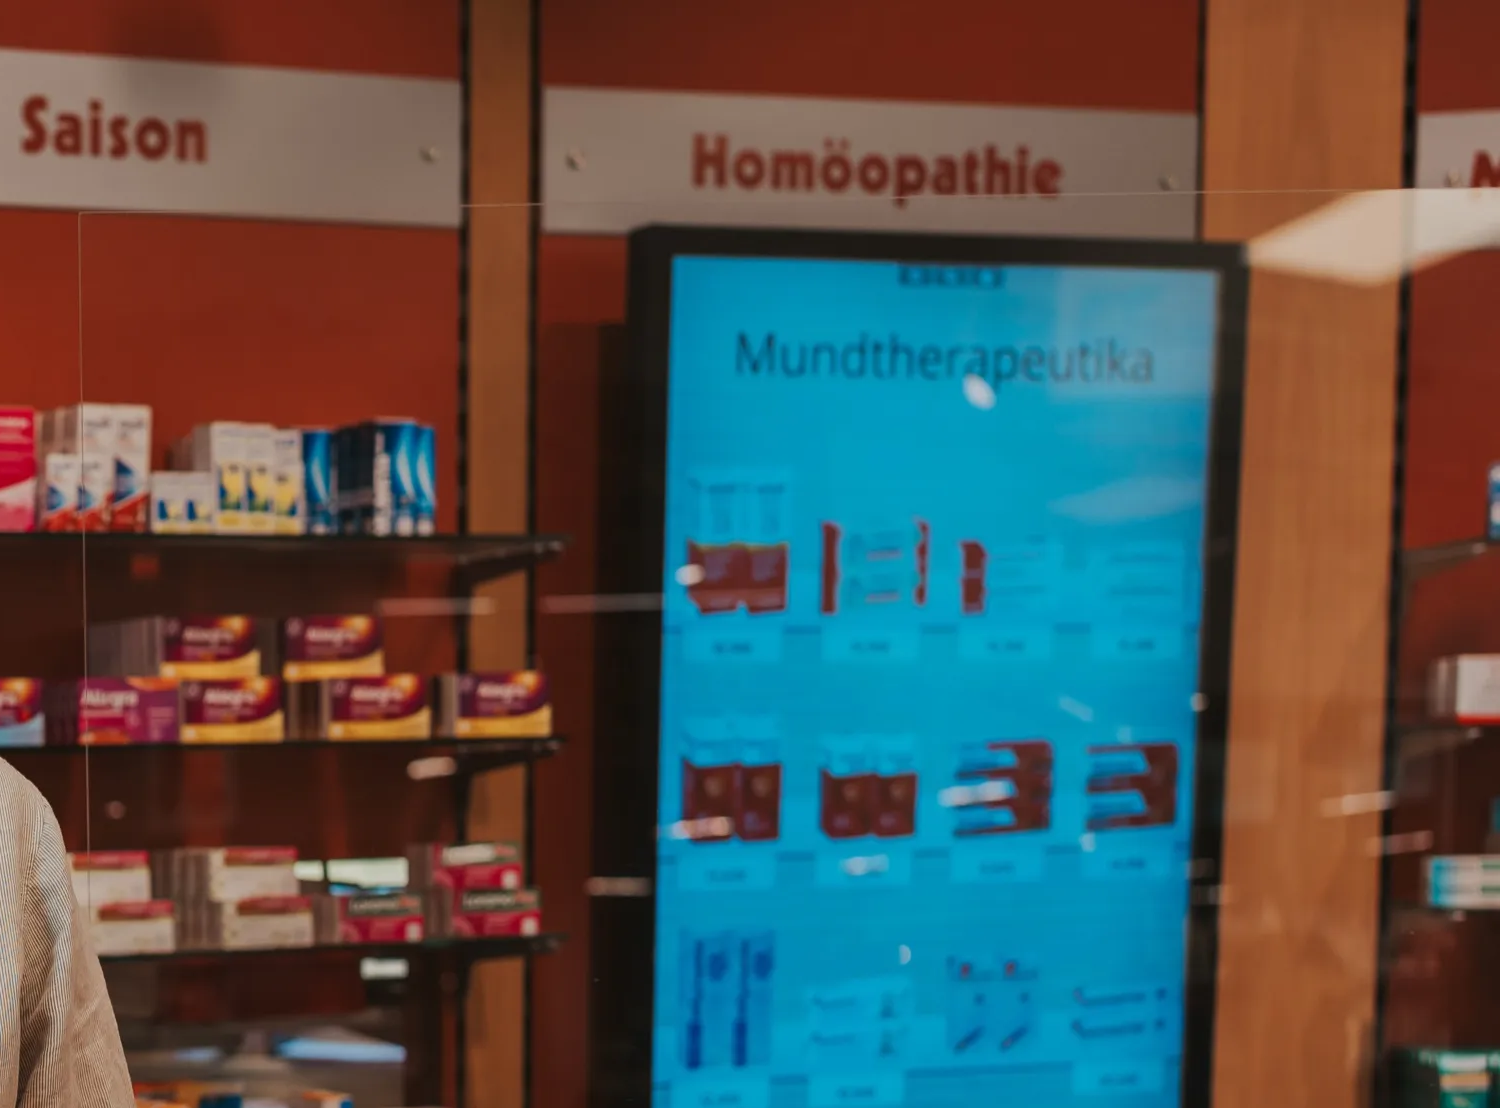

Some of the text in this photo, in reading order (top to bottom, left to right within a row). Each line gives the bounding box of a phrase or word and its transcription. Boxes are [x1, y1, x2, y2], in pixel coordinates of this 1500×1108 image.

[21, 96, 208, 163] Saison
[691, 133, 1063, 207] Homöopathie
[735, 332, 1155, 393] Mundtherapeutika
